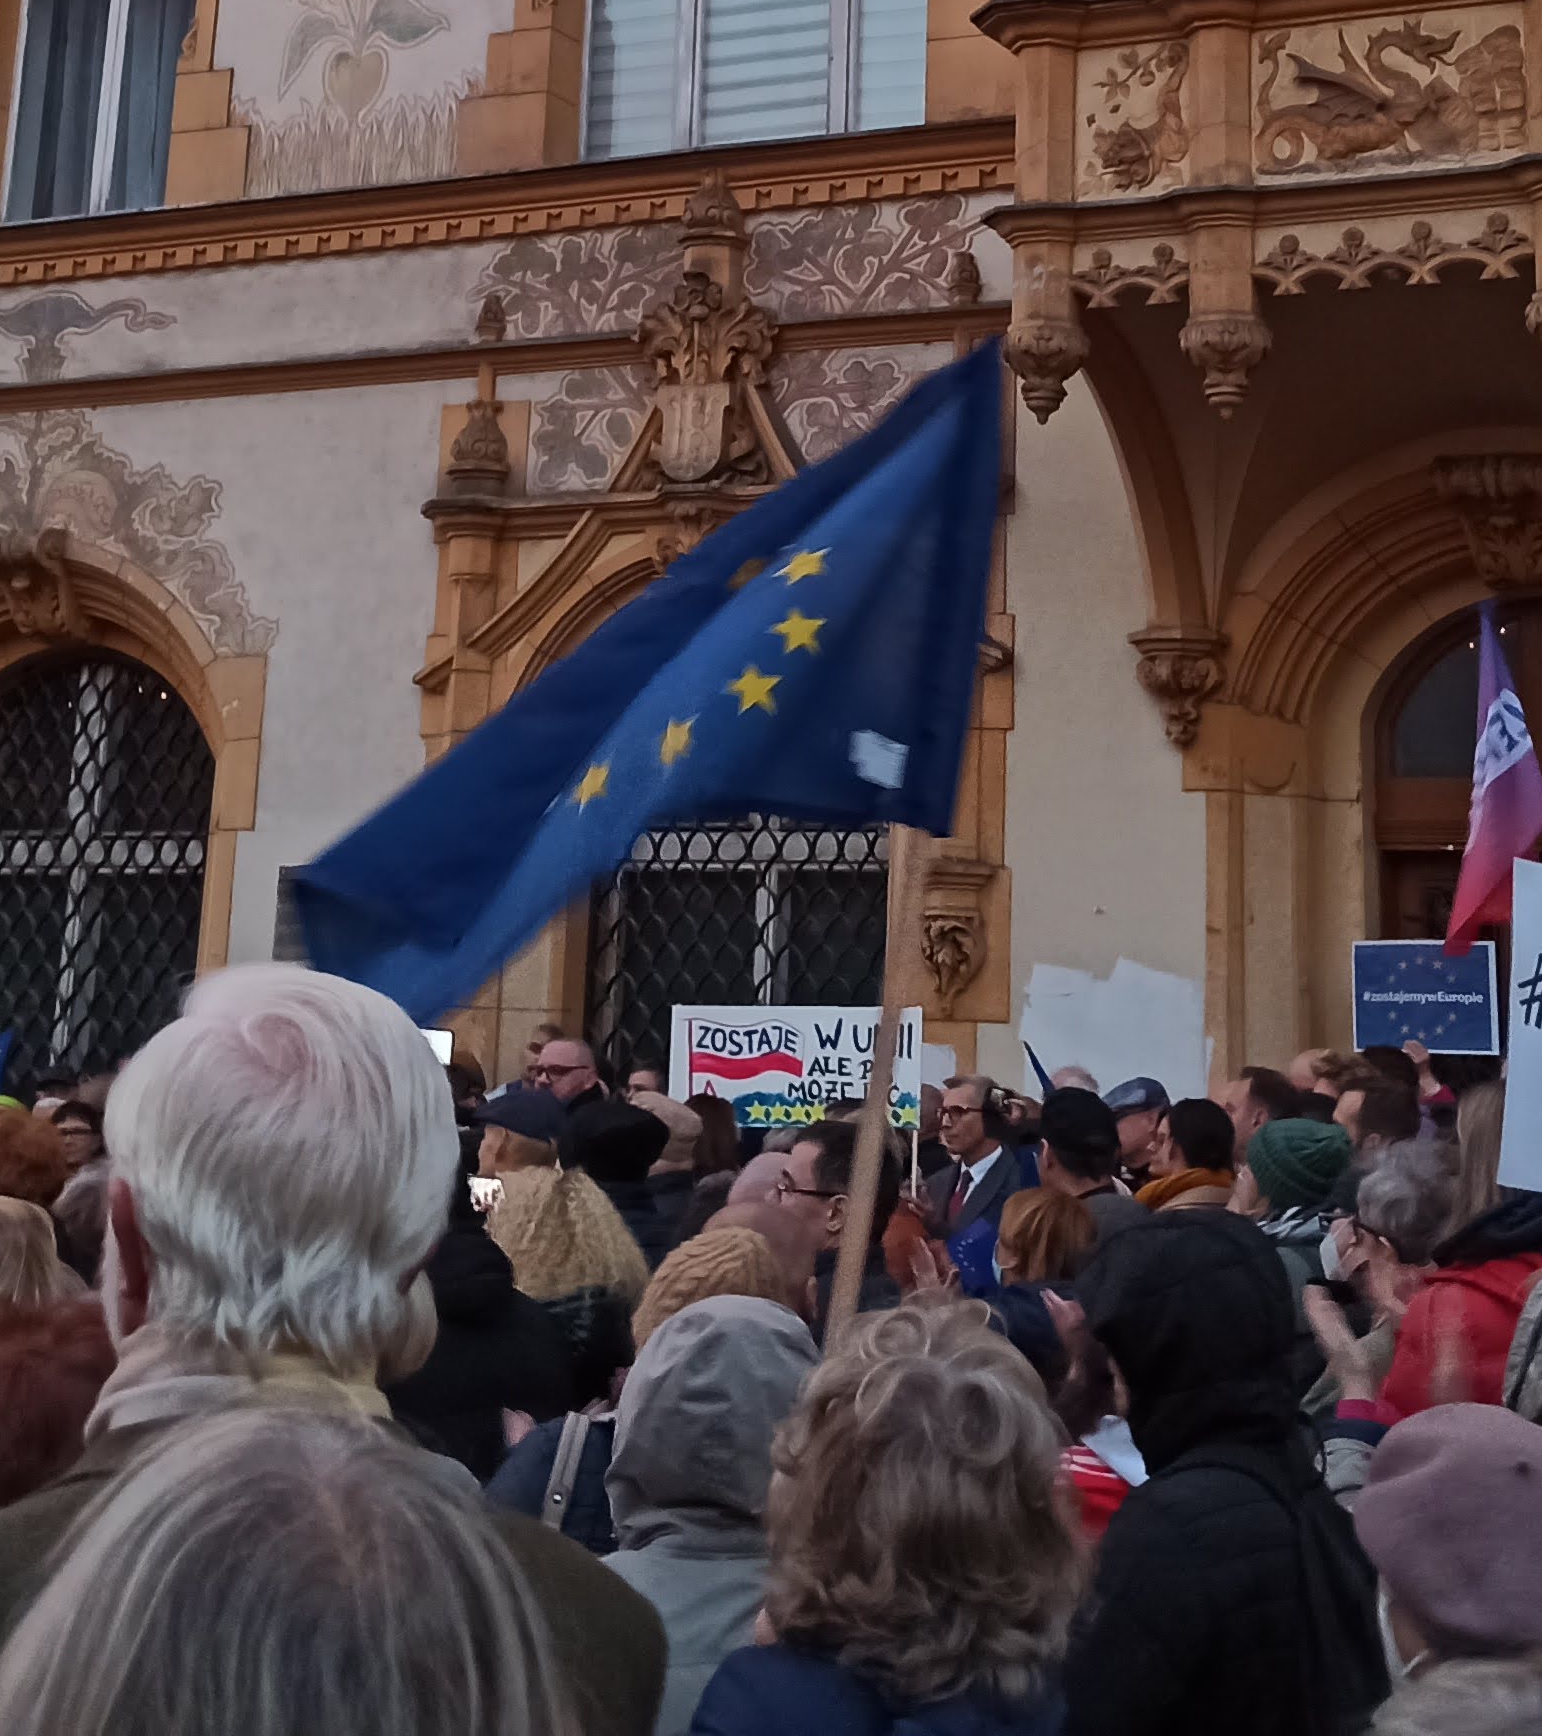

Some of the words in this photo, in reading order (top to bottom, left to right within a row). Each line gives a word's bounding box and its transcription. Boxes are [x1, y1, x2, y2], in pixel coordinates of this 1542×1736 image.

[814, 1018, 843, 1051] W
[853, 1022, 914, 1059] UII
[807, 1057, 853, 1077] ALE
